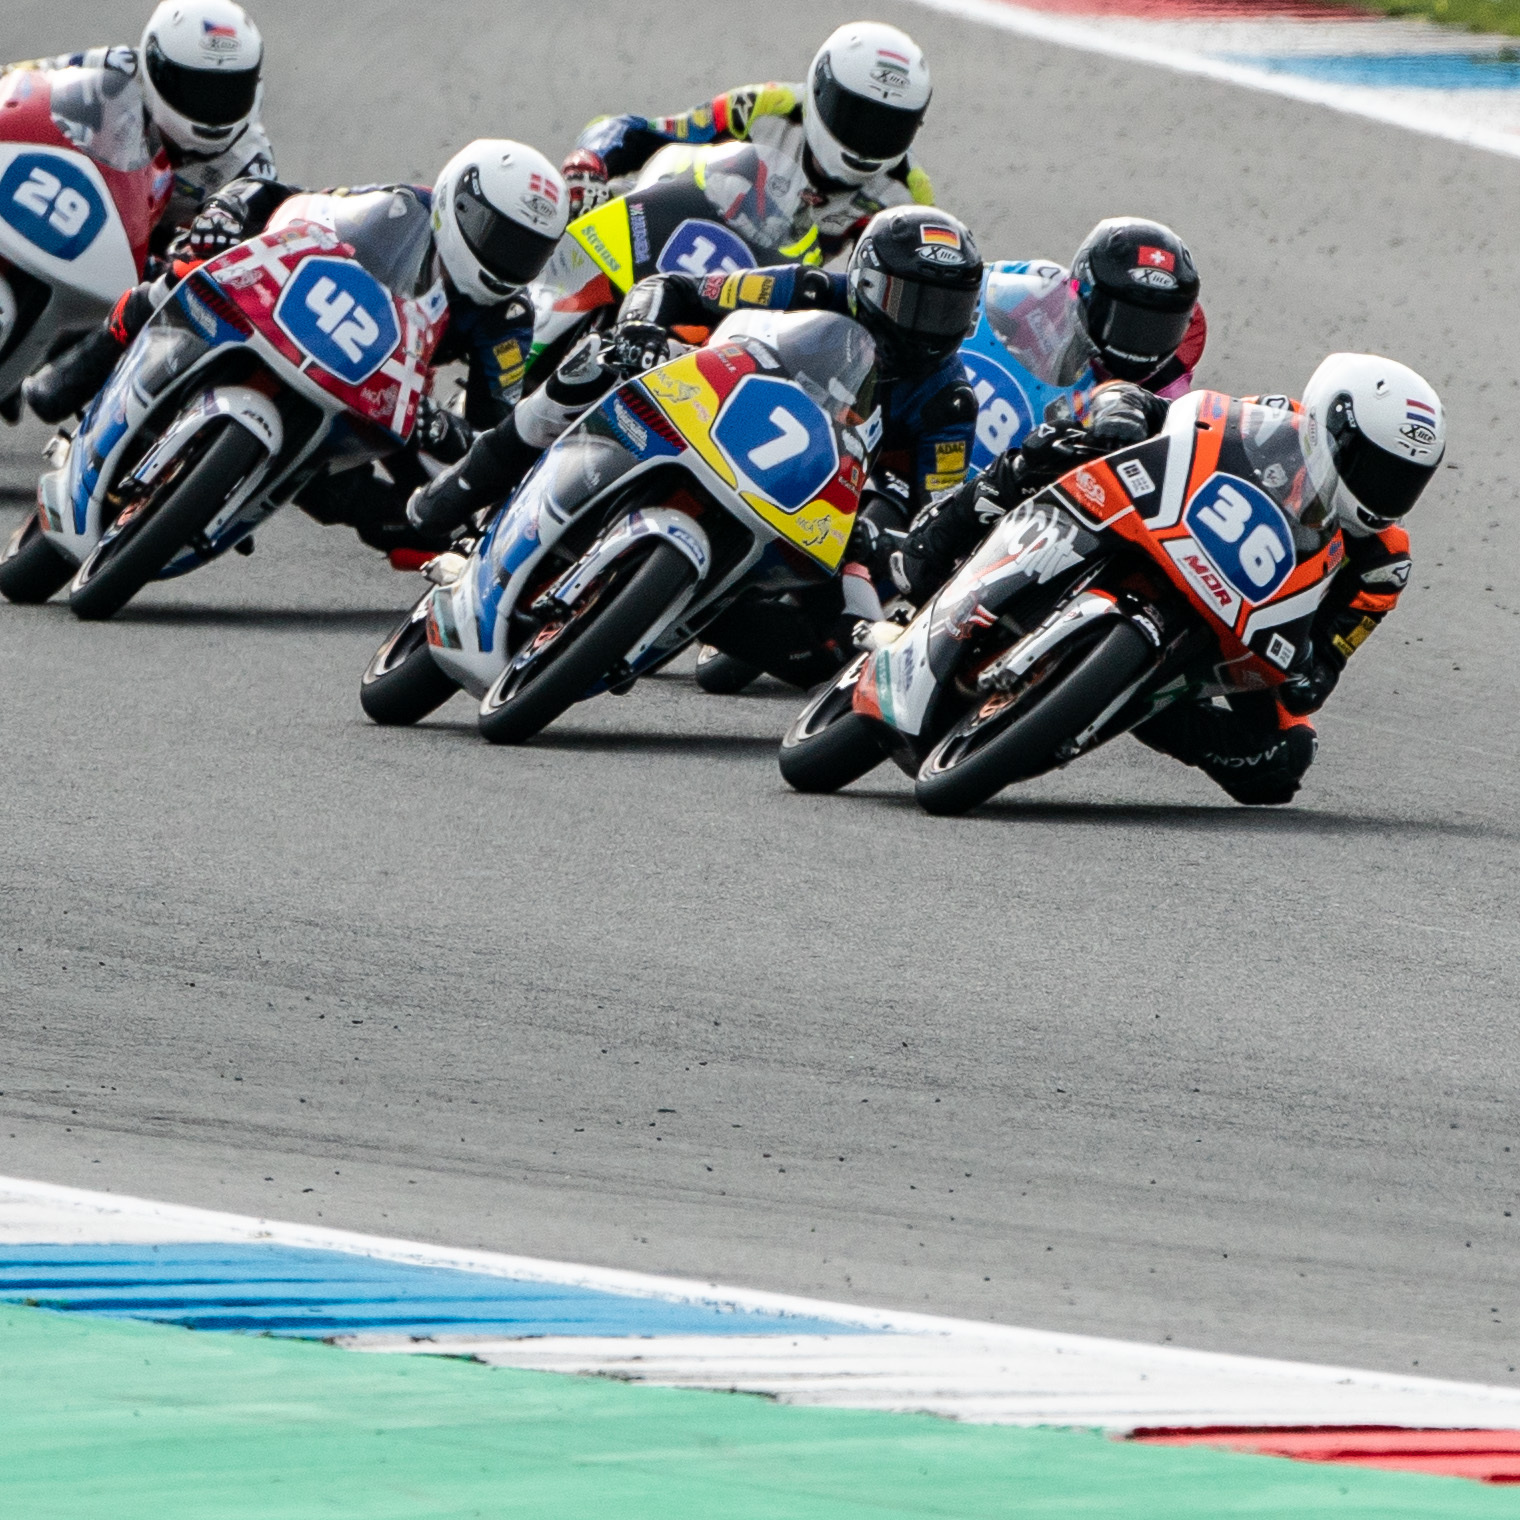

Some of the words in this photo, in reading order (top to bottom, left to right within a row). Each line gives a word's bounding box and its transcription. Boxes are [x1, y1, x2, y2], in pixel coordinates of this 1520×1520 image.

[12, 167, 91, 239] 29
[305, 276, 380, 364] 42
[747, 406, 810, 471] 7
[937, 441, 965, 455] ADAC
[1196, 484, 1286, 587] 36
[1183, 554, 1233, 607] MDR
